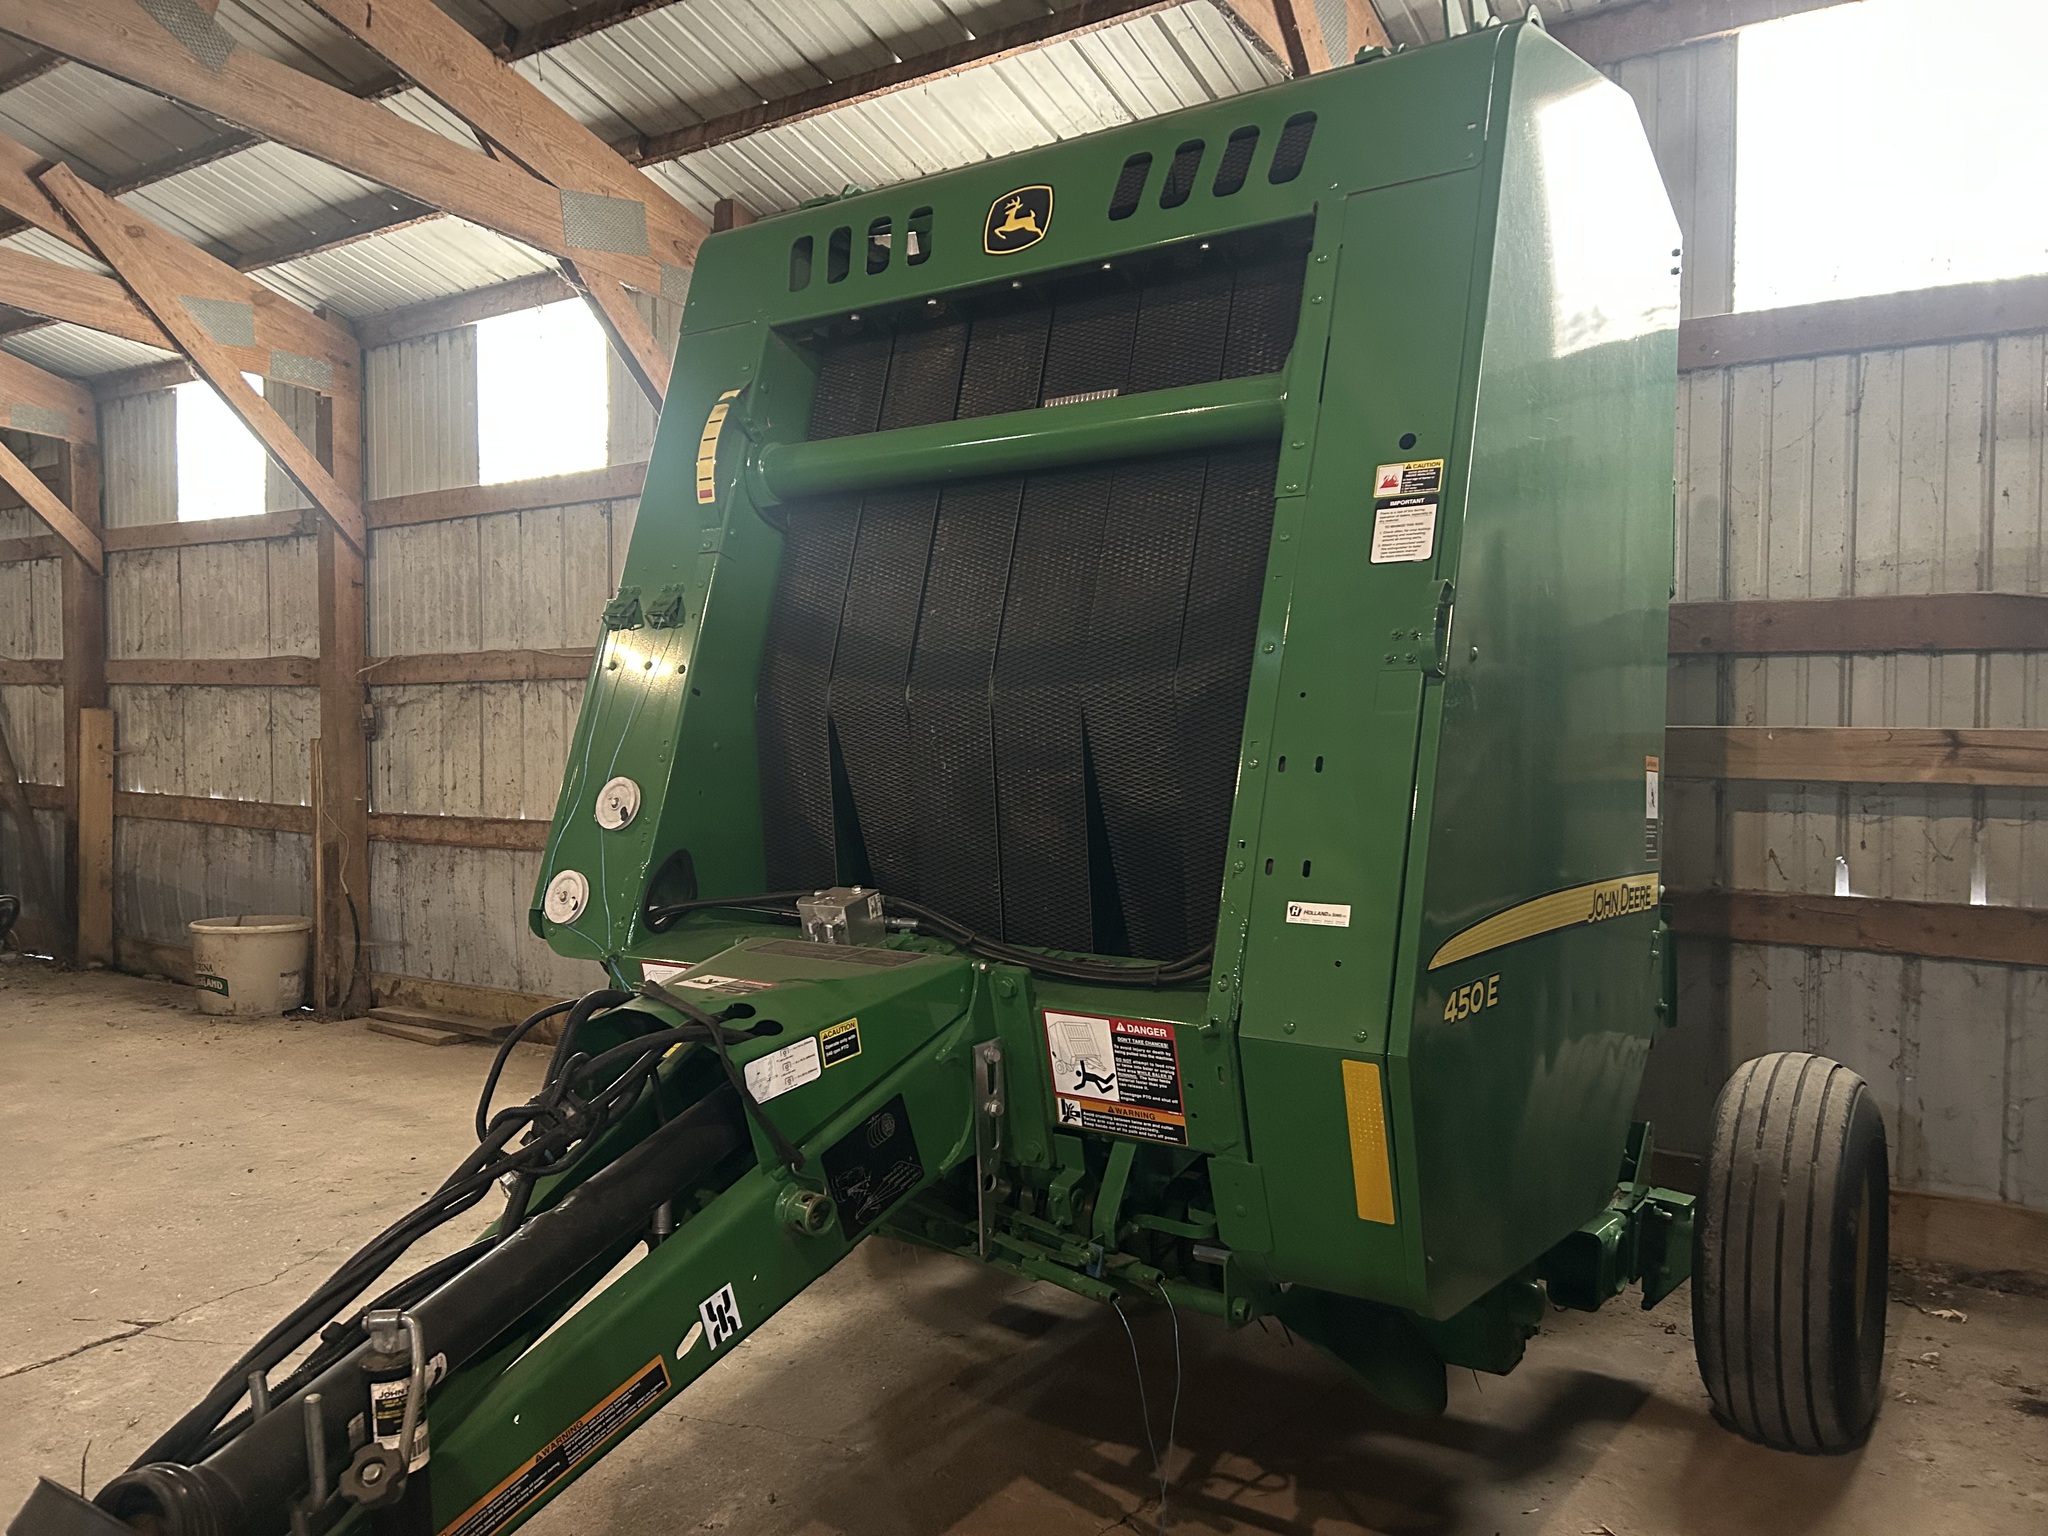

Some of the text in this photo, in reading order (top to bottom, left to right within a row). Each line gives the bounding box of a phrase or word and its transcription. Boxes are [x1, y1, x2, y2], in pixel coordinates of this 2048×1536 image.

[1390, 498, 1425, 506] IMPORTANT
[1588, 883, 1651, 919] JOHN DEERE
[827, 1022, 856, 1038] CAUTION
[1127, 1024, 1167, 1038] DANGER
[1114, 1109, 1156, 1121] WARNING
[379, 1390, 404, 1399] JOHN
[541, 1421, 583, 1457] WARNING
